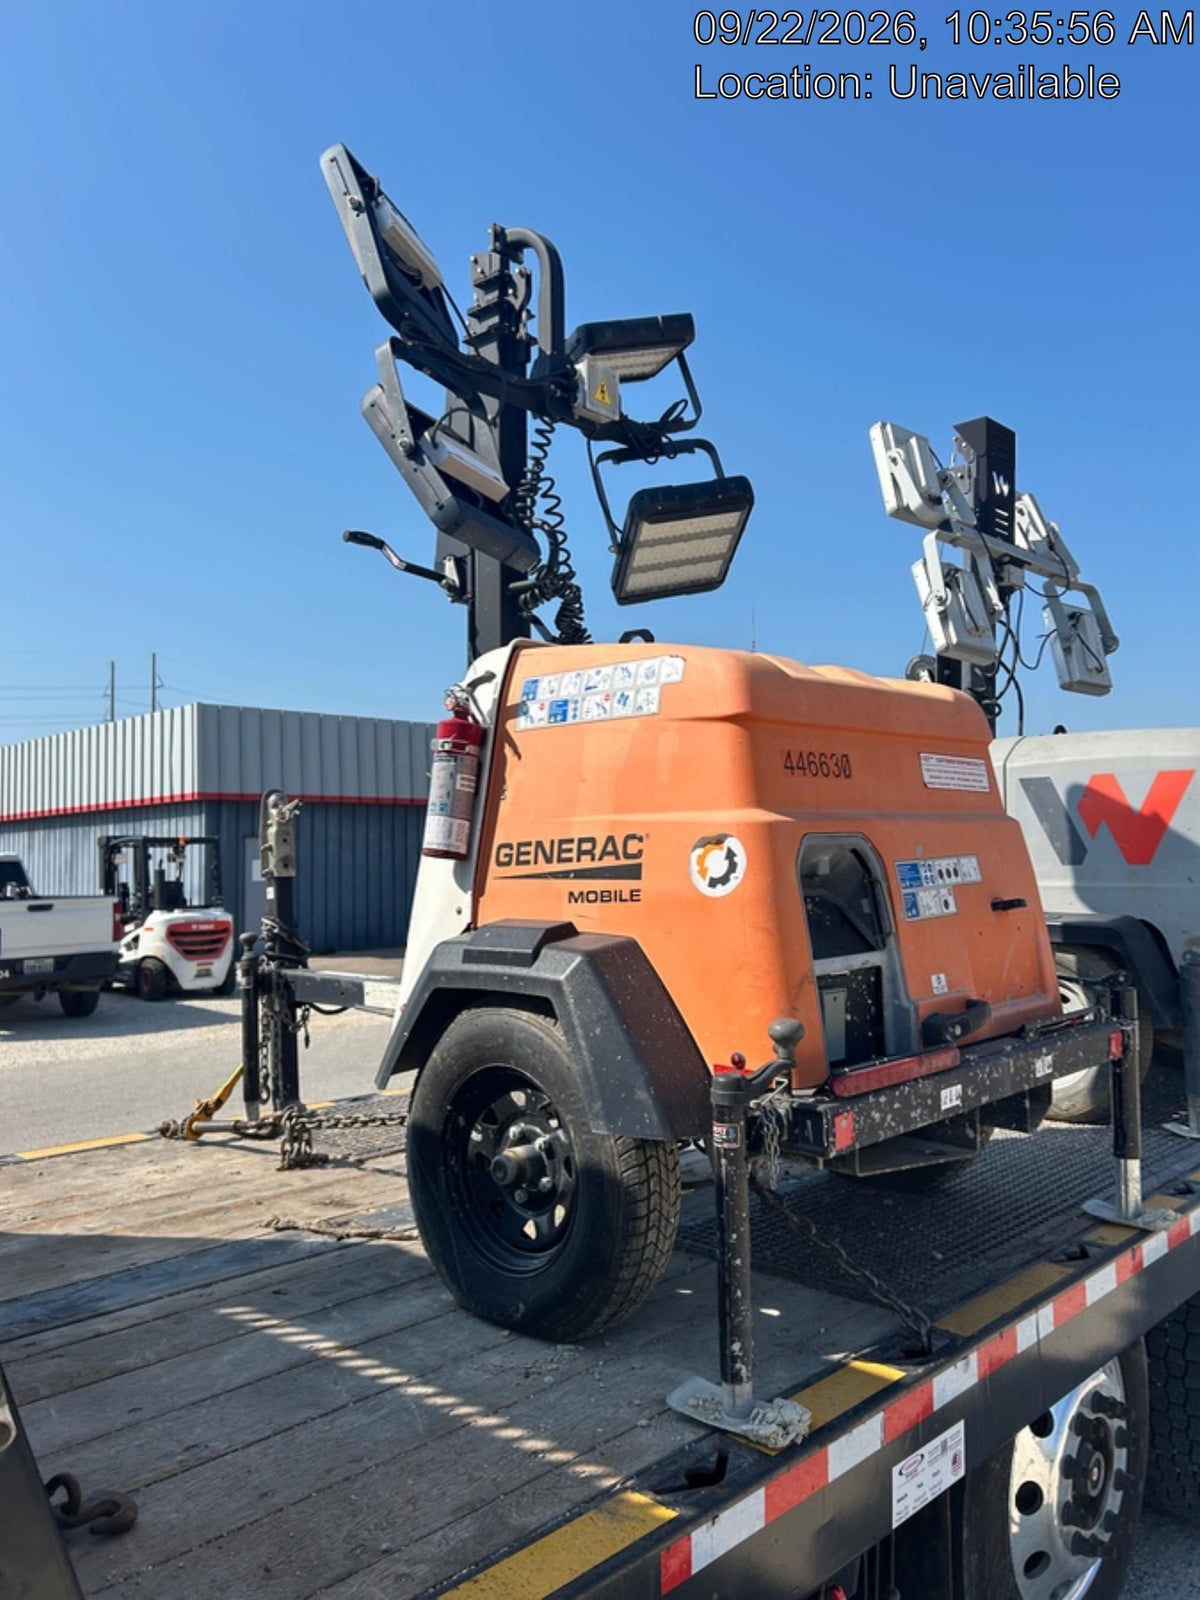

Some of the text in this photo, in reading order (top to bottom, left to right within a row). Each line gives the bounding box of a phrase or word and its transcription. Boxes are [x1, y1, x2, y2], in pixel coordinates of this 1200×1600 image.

[783, 750, 853, 779] 446630
[495, 833, 645, 867] GENERAC
[568, 889, 642, 904] MOBILE
